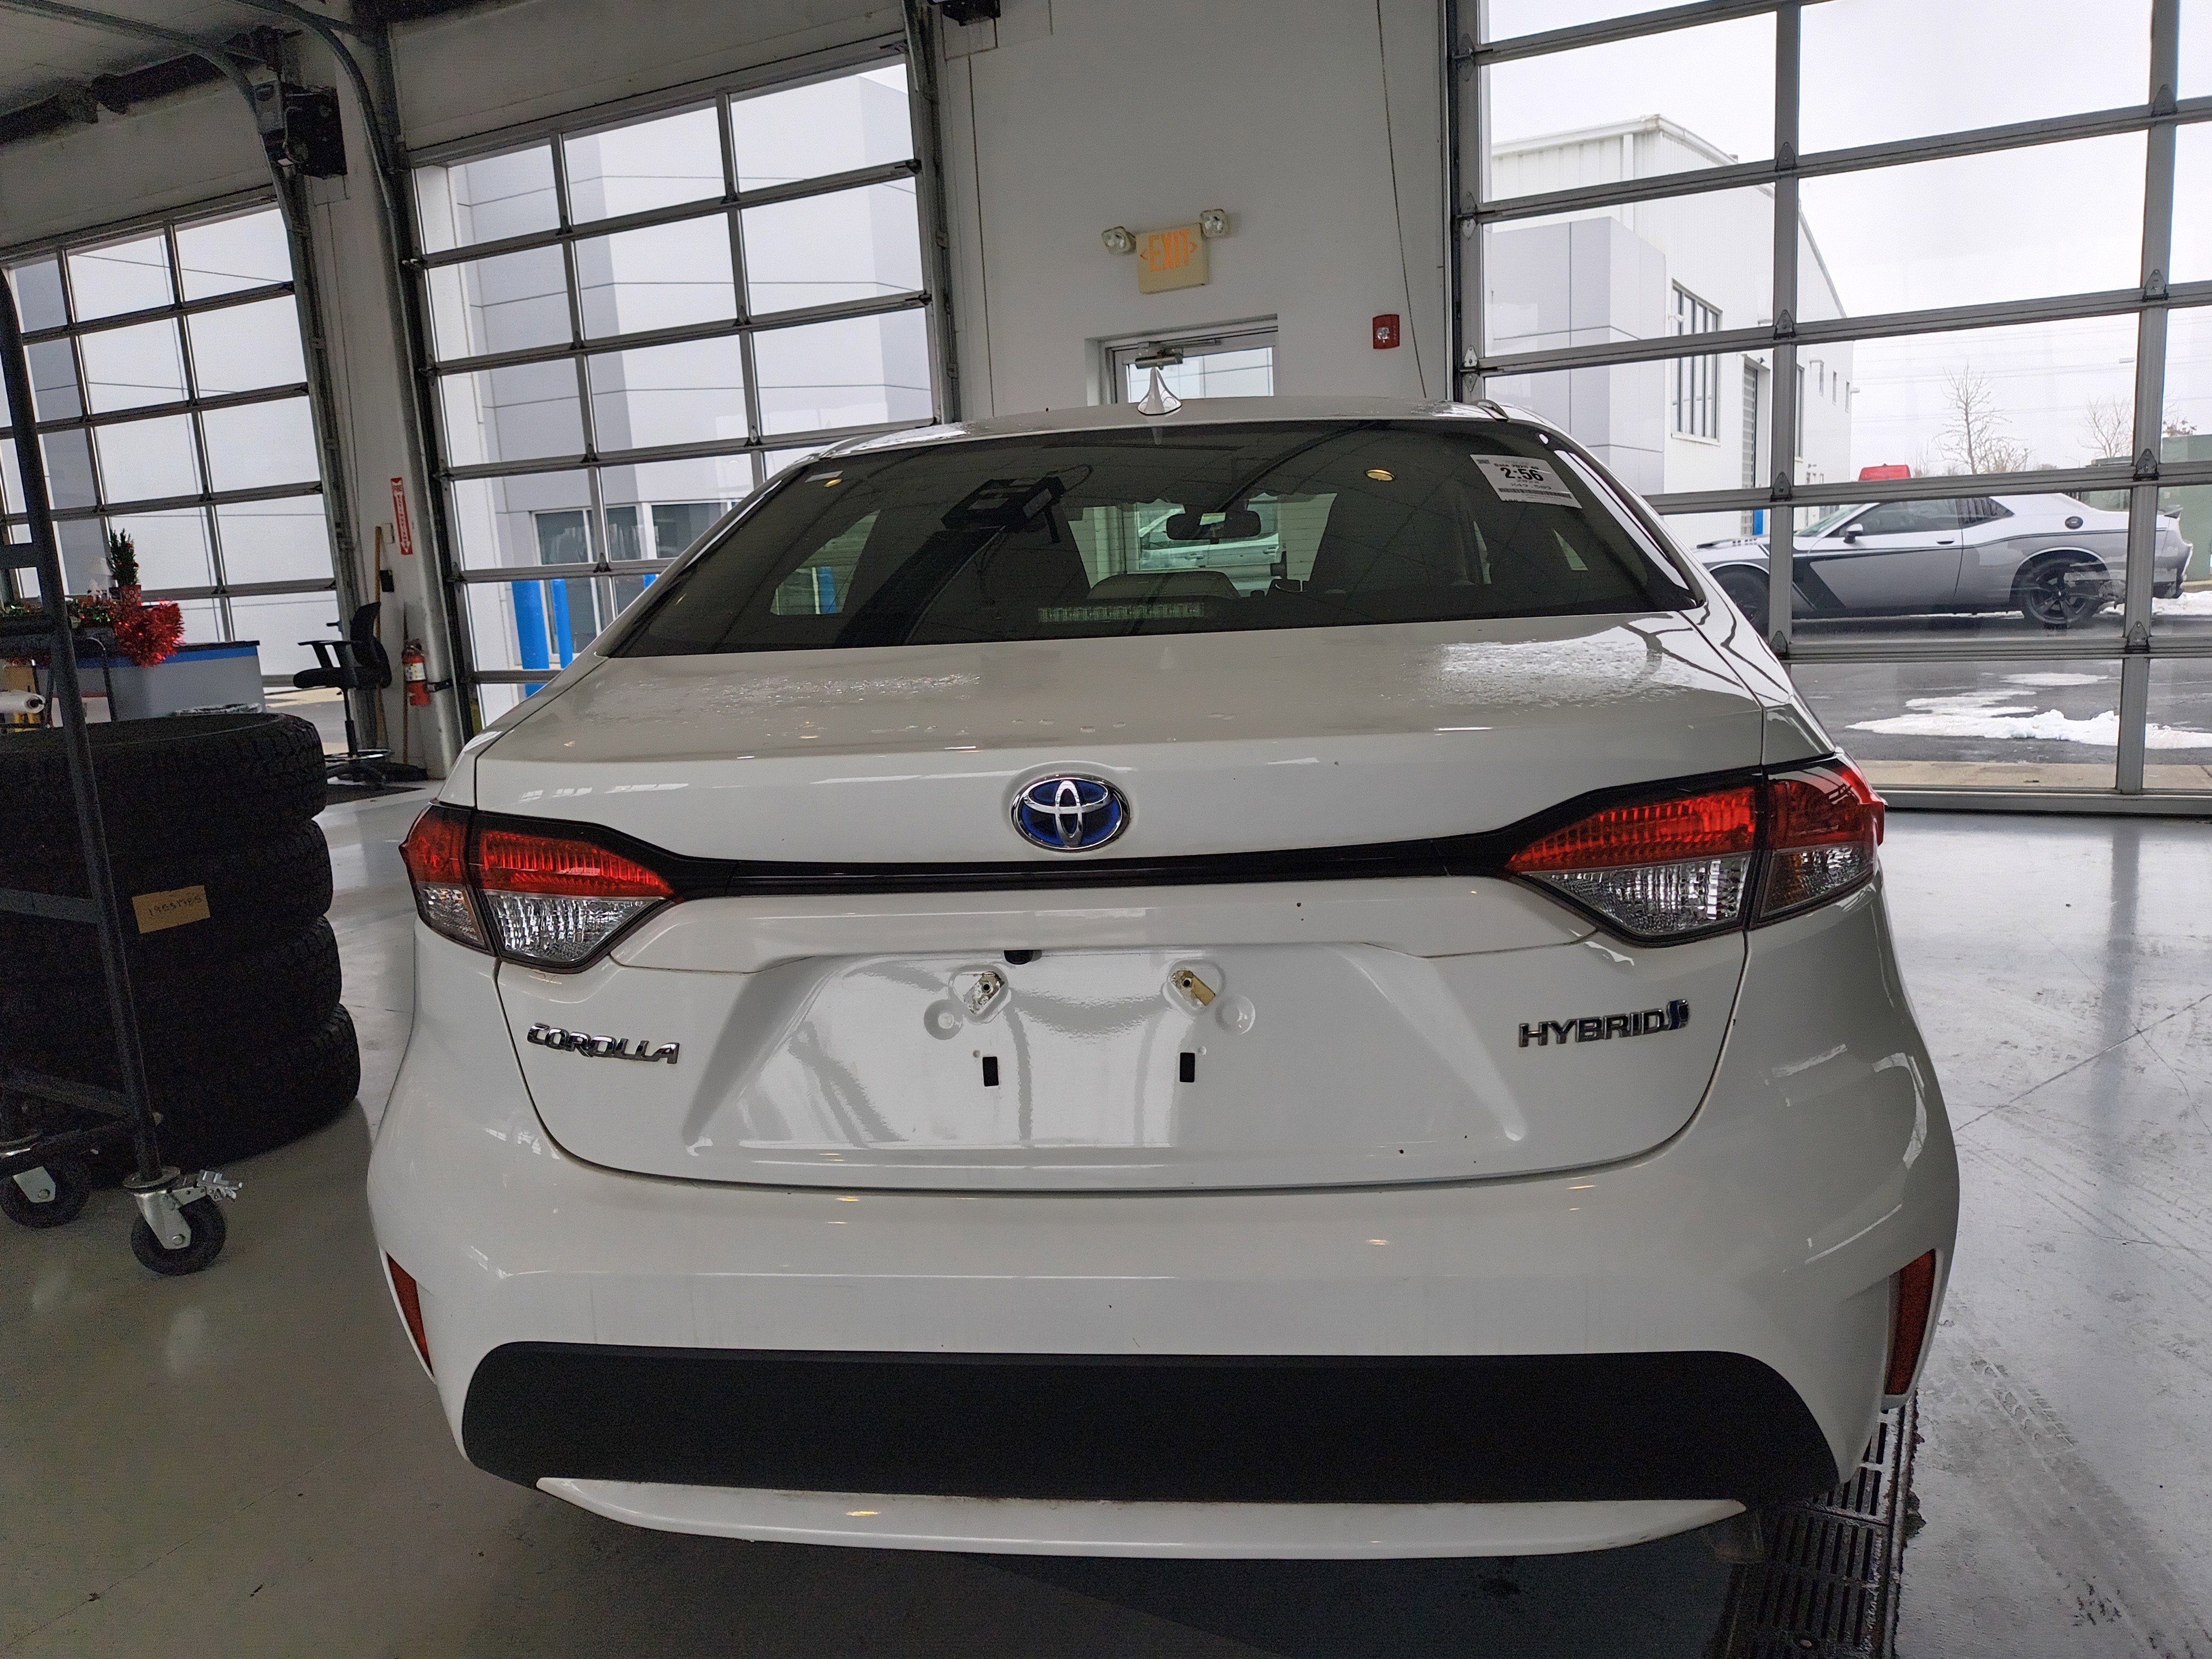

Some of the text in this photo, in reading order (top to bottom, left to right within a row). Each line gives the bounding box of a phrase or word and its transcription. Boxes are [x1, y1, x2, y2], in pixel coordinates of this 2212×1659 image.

[1148, 229, 1190, 272] EXIT
[1500, 468, 1543, 481] 2:56
[527, 1023, 680, 1064] COROLLA
[1519, 1008, 1665, 1048] HYBRID
